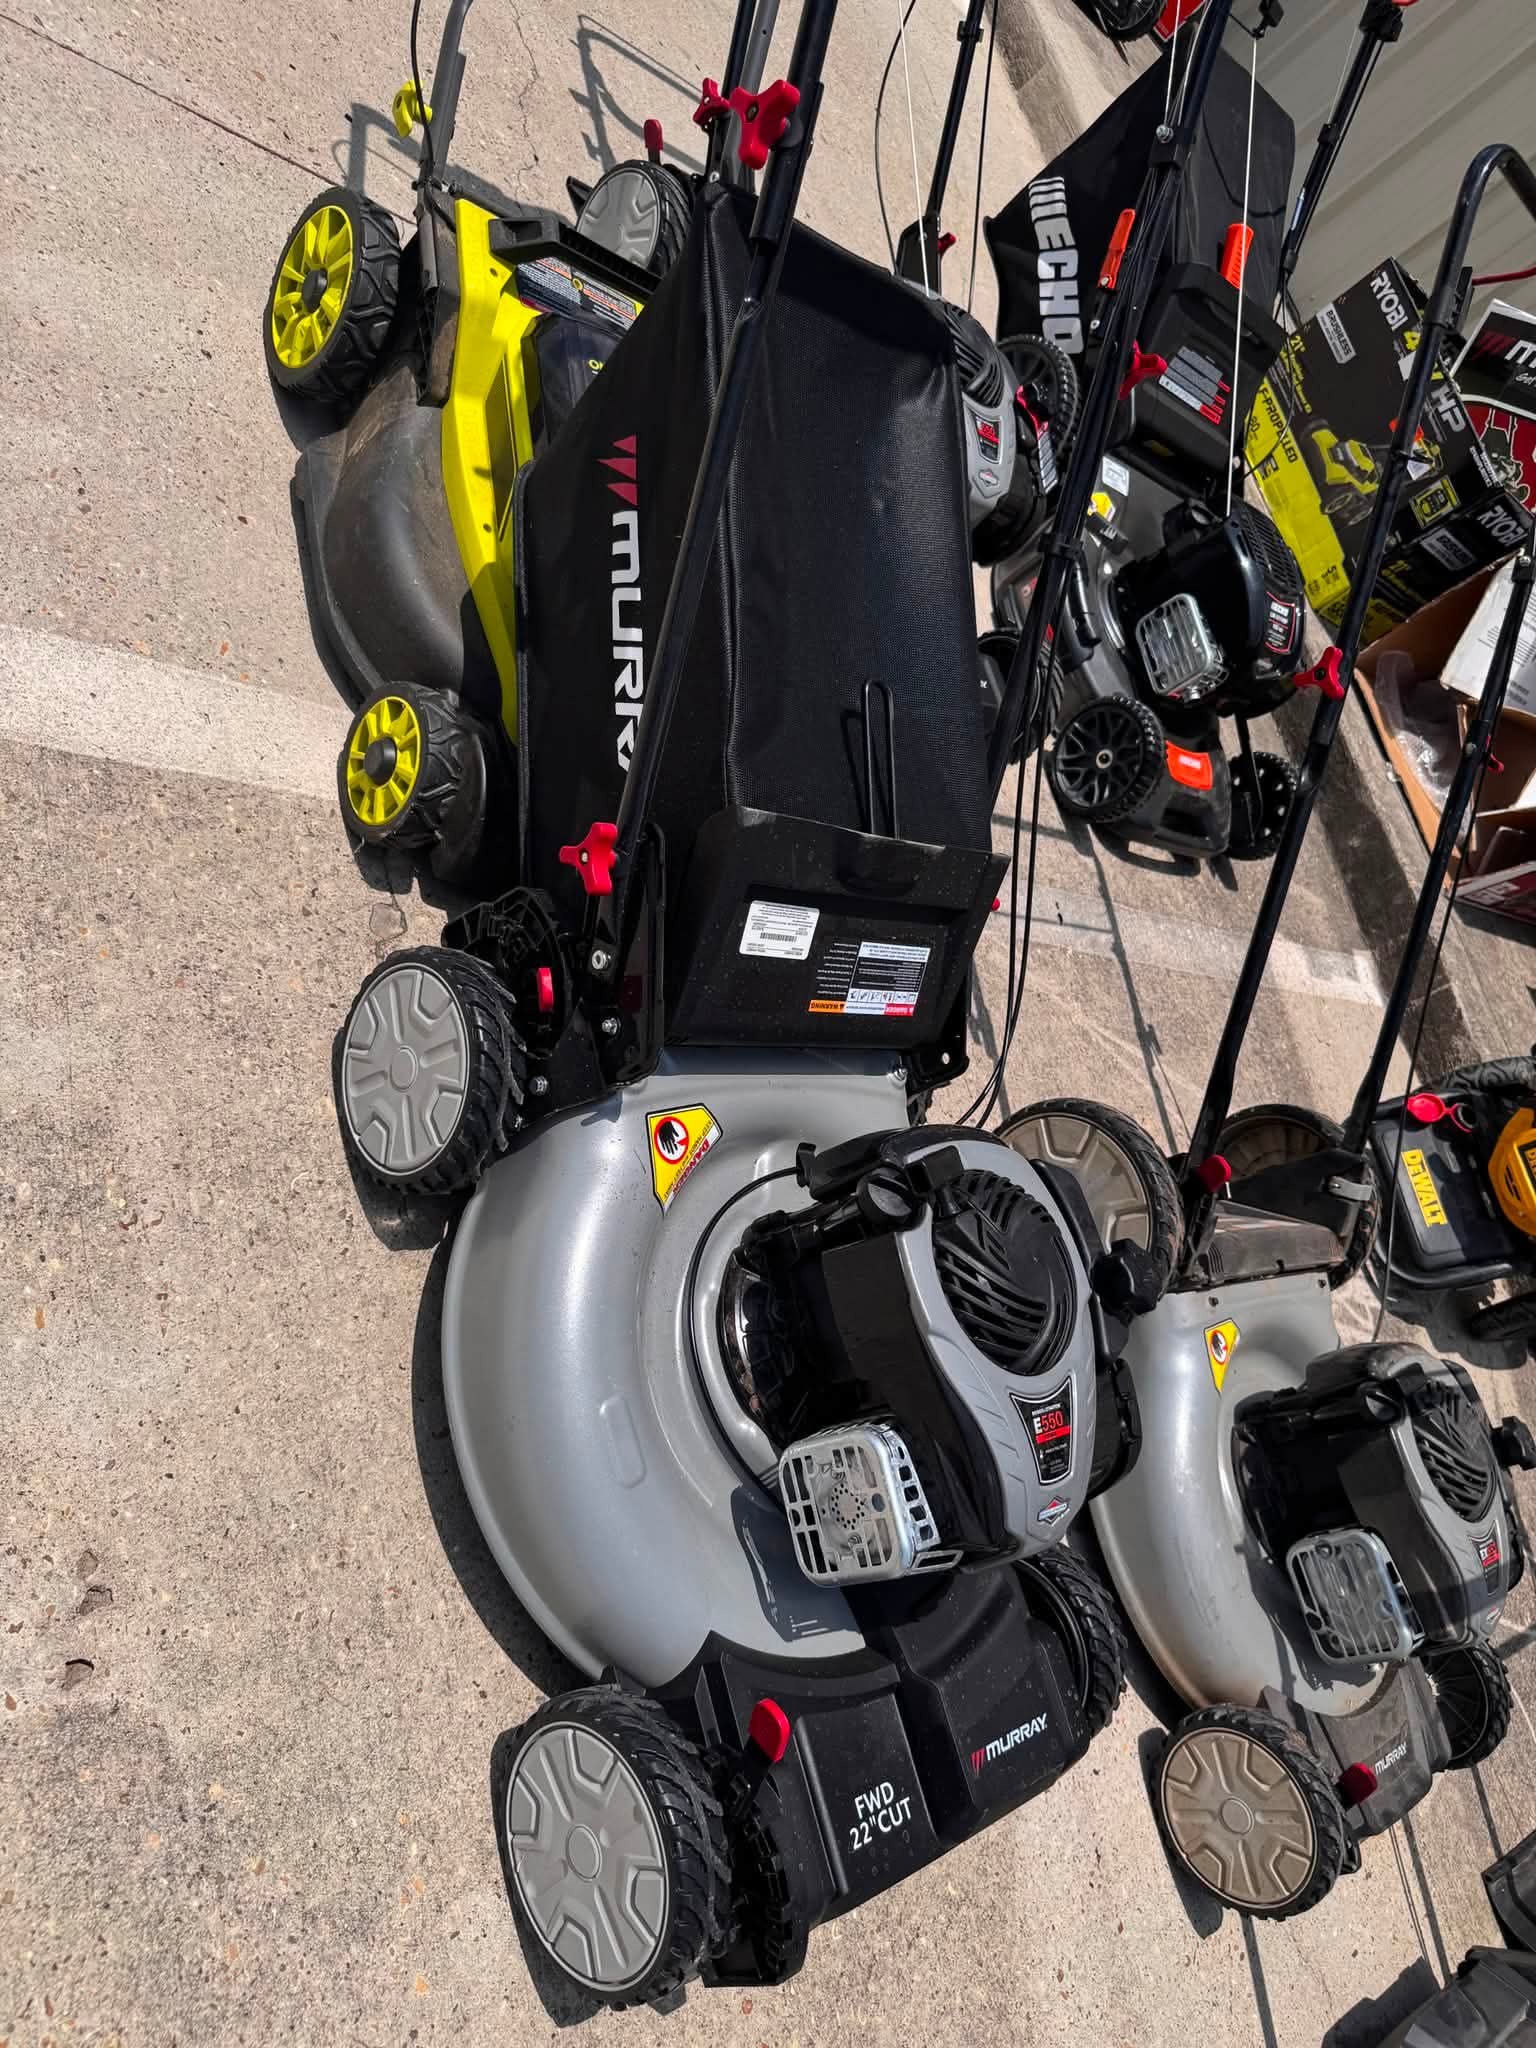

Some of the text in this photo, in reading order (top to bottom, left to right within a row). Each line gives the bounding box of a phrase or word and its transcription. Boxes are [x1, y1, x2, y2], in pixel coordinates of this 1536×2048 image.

[1034, 216, 1085, 354] ECHO
[1369, 272, 1409, 331] RYOBI
[1326, 309, 1352, 356] BRUSHLESS
[1430, 384, 1466, 432] HP
[1477, 504, 1529, 547] RYOBI
[811, 1001, 840, 1010] WARNING
[1401, 1148, 1448, 1228] DEWALT
[1033, 1410, 1064, 1434] E550
[986, 1713, 1048, 1761] MURRAY
[1375, 1741, 1407, 1776] MURRAY
[854, 1781, 894, 1820] FWD
